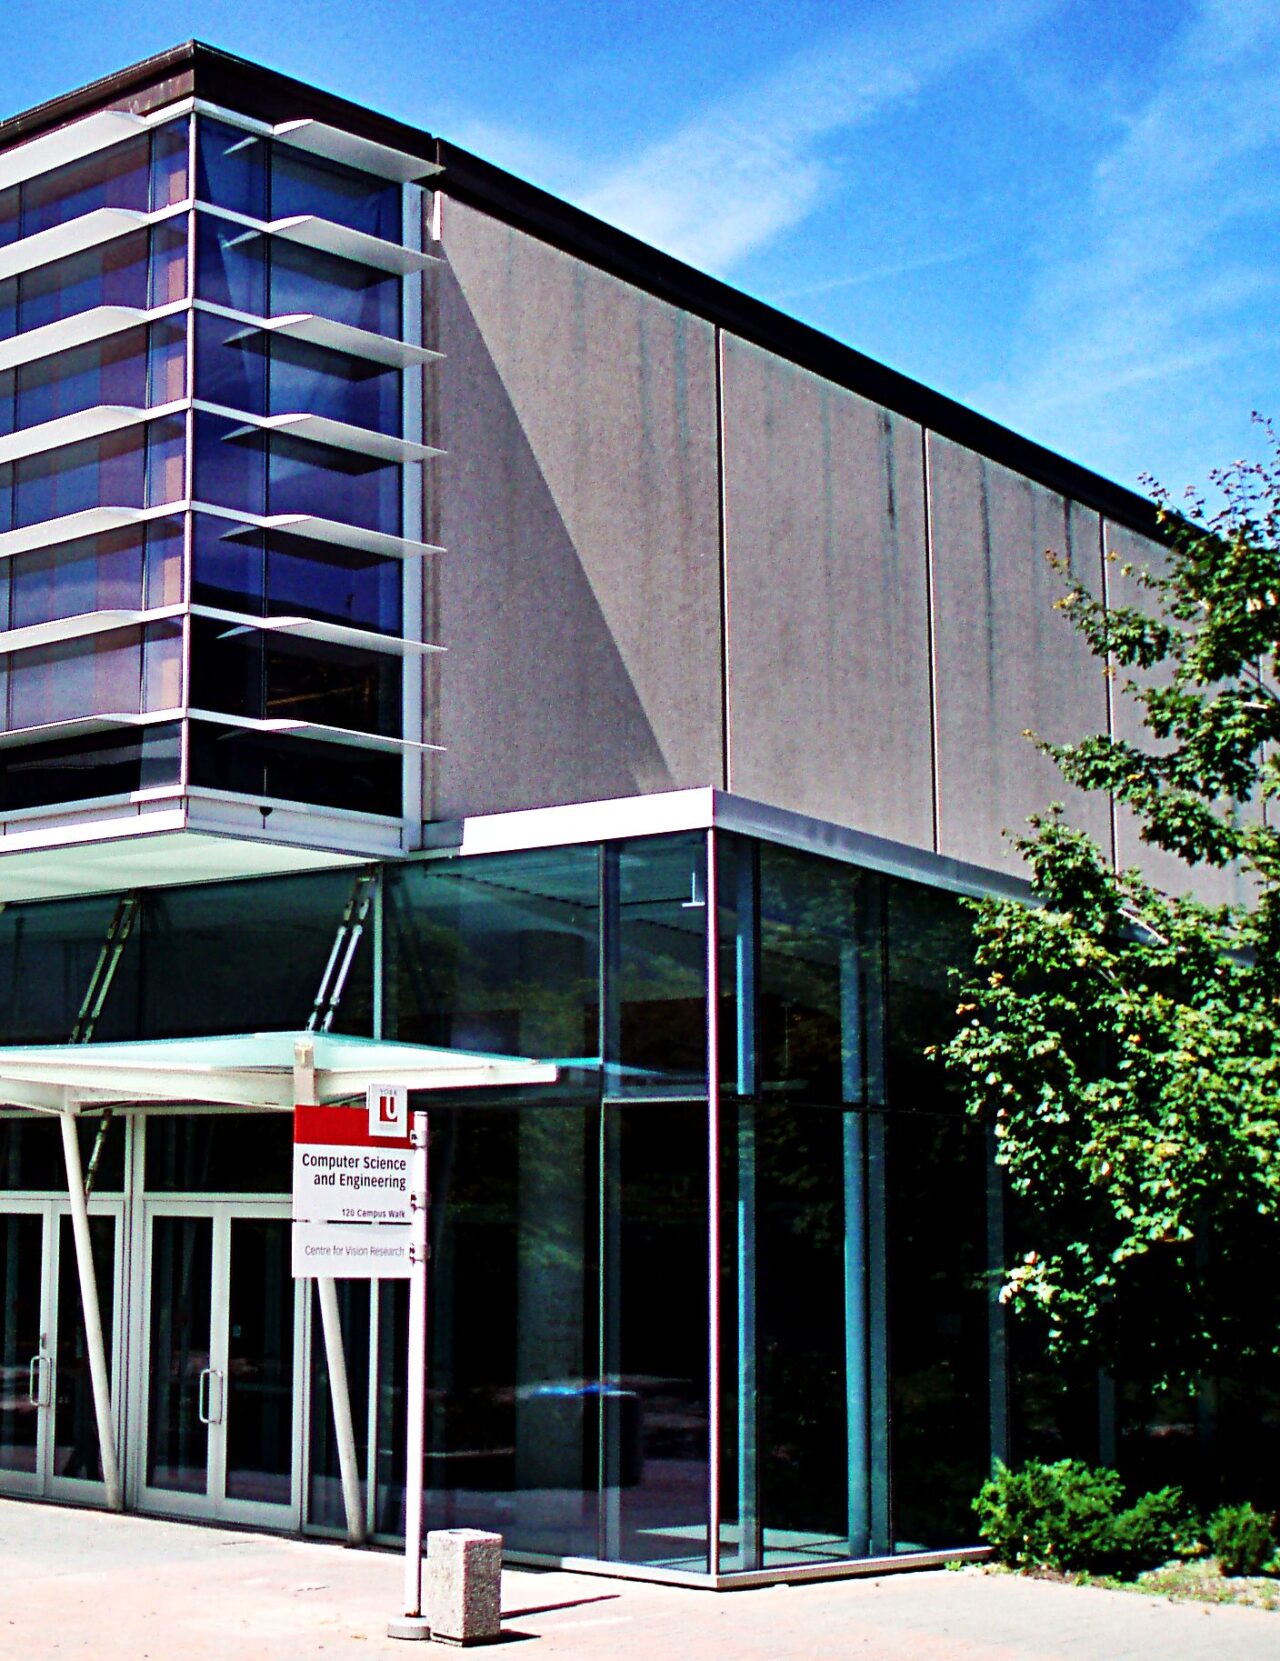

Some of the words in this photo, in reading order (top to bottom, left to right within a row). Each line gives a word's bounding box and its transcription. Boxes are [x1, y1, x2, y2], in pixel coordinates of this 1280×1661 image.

[302, 1153, 359, 1170] Computer
[363, 1156, 407, 1170] Science
[314, 1173, 335, 1185] and
[340, 1173, 406, 1191] Engineering
[342, 1208, 355, 1217] 120
[357, 1209, 386, 1218] Campus
[388, 1210, 405, 1218] Walk
[305, 1245, 331, 1256] Centre
[333, 1245, 343, 1255] for
[345, 1246, 368, 1256] Vision
[370, 1246, 405, 1257] Research
